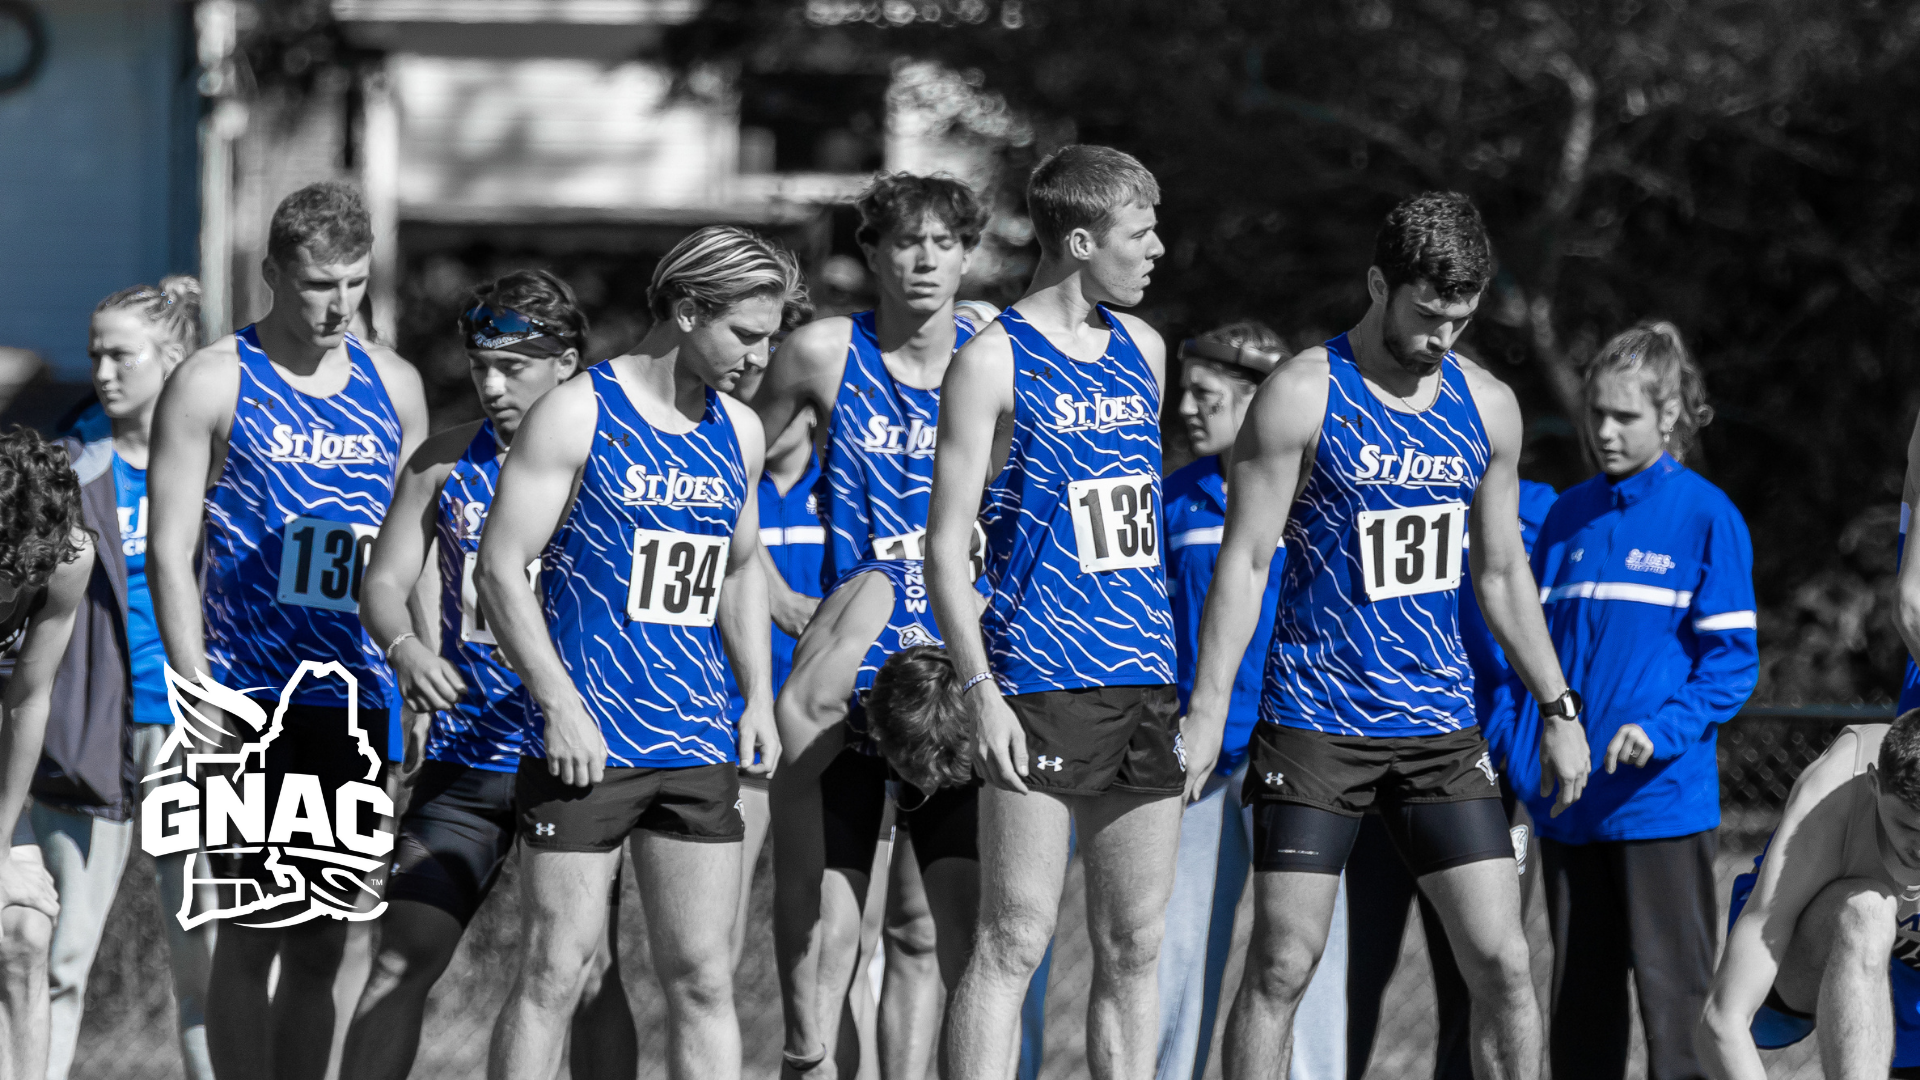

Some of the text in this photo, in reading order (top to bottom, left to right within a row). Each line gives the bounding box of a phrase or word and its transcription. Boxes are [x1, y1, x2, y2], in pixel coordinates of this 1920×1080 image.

[1078, 484, 1156, 558] 133
[1365, 512, 1452, 589] 131
[638, 539, 722, 615] 134
